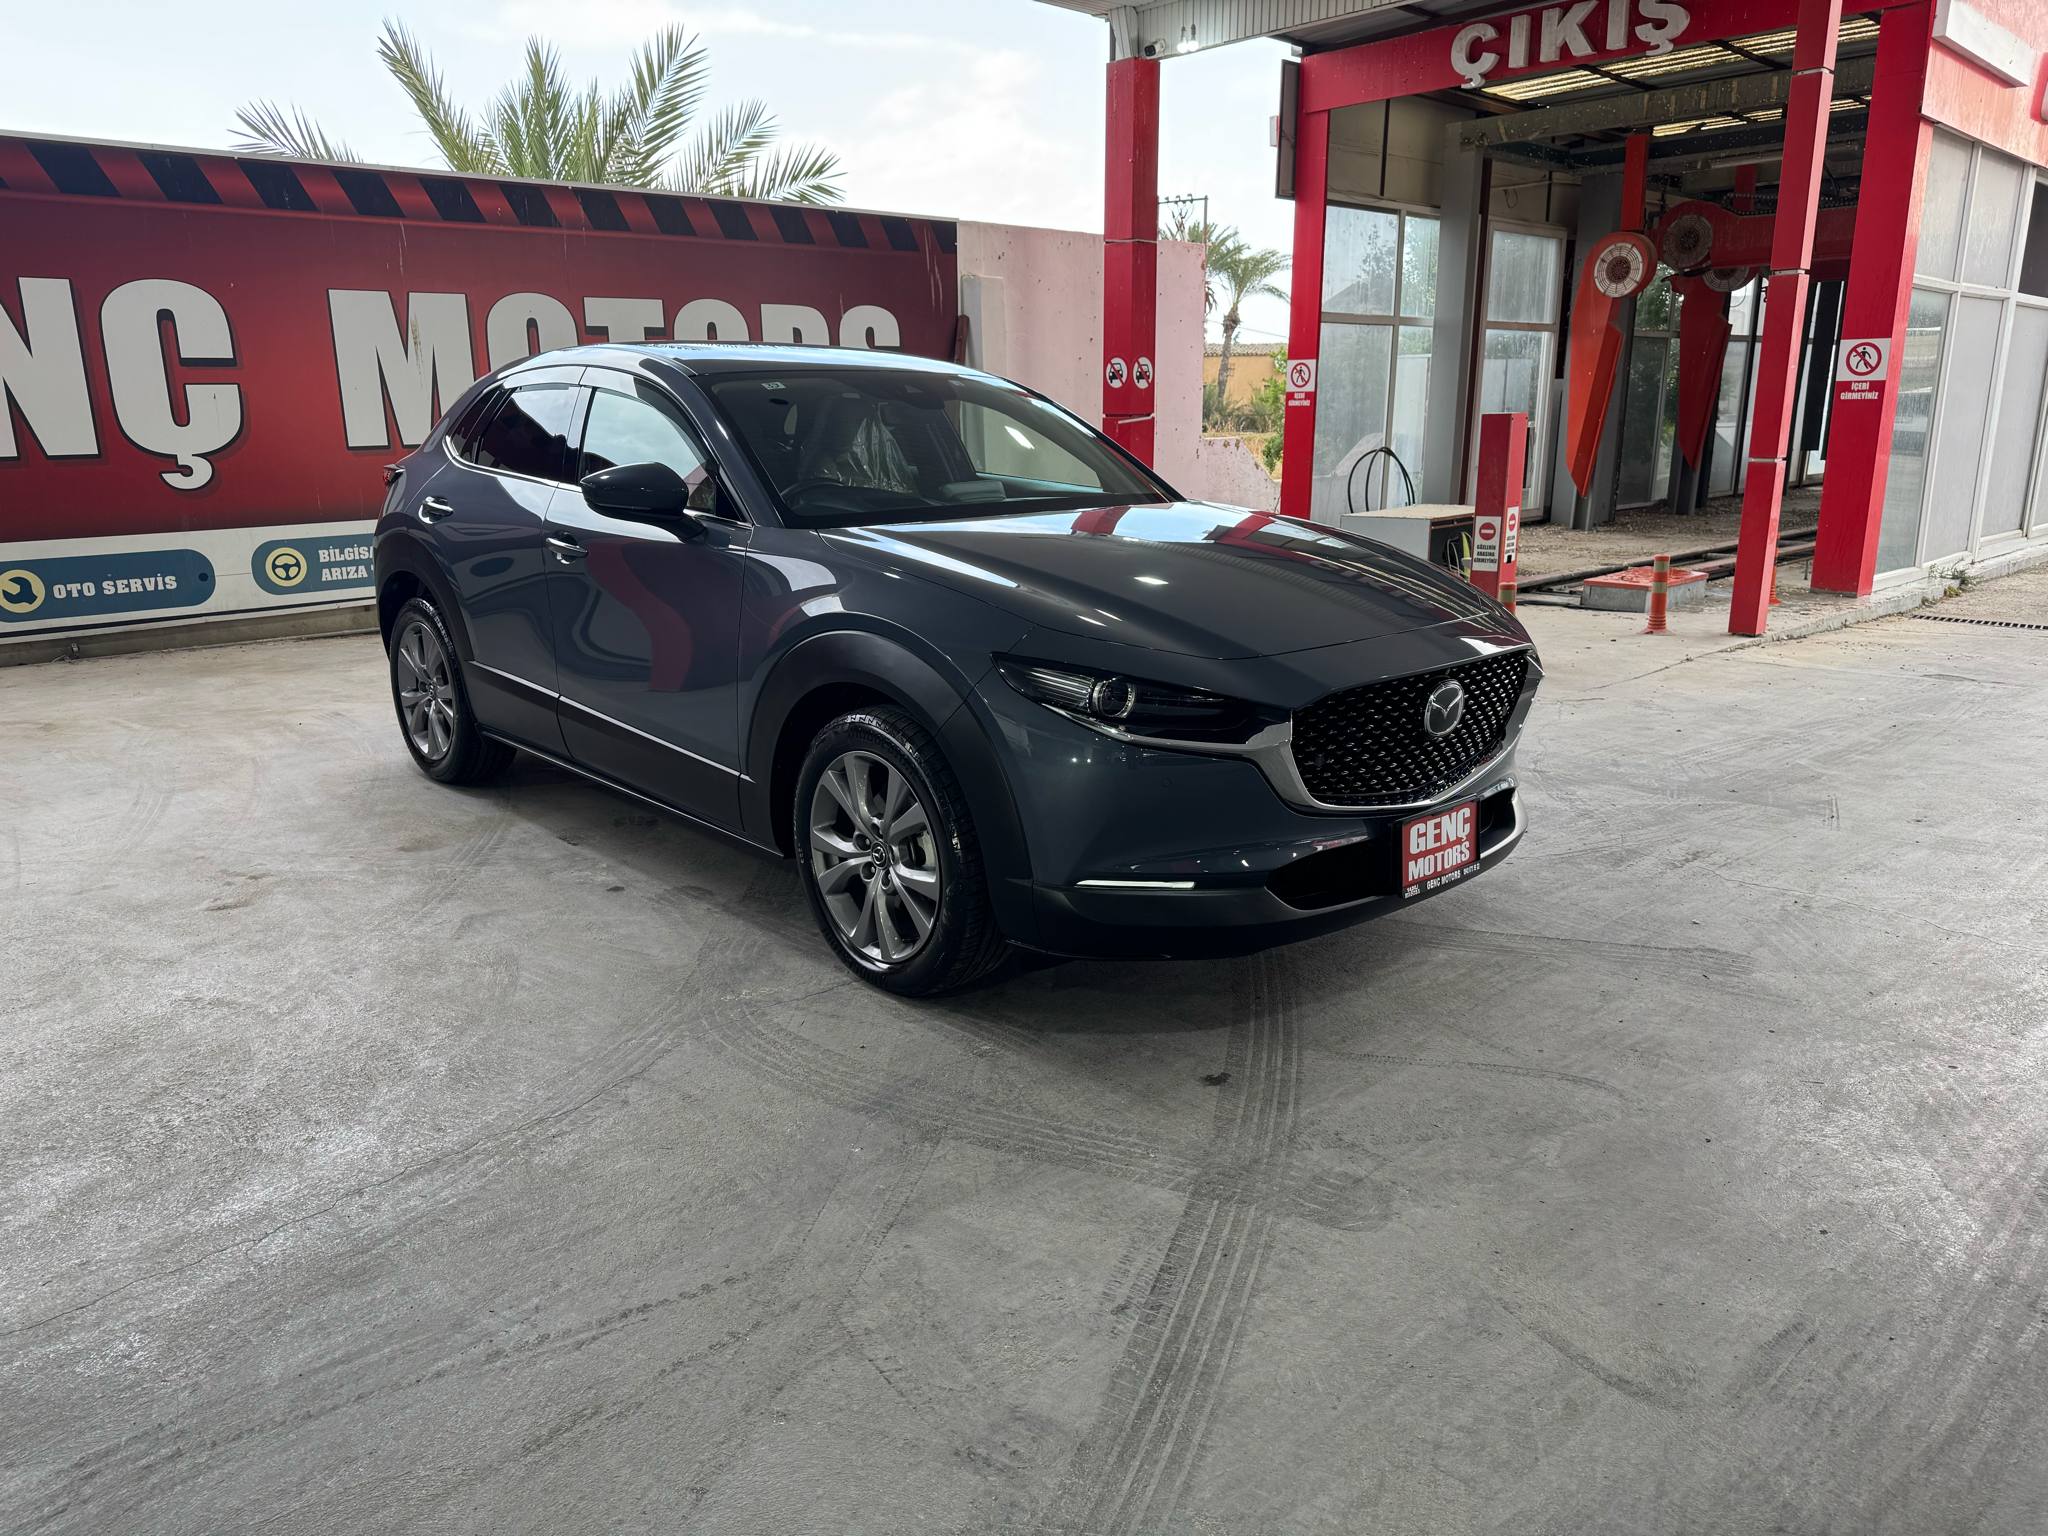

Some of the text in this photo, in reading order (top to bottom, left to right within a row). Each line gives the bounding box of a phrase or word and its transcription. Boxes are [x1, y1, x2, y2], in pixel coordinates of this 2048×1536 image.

[1450, 0, 1691, 89] ÇIKIŞ
[52, 573, 178, 600] OTO SERVİS
[321, 565, 369, 582] ARIZA
[1409, 807, 1471, 855] GENÇ
[1408, 840, 1470, 882] MOTORS
